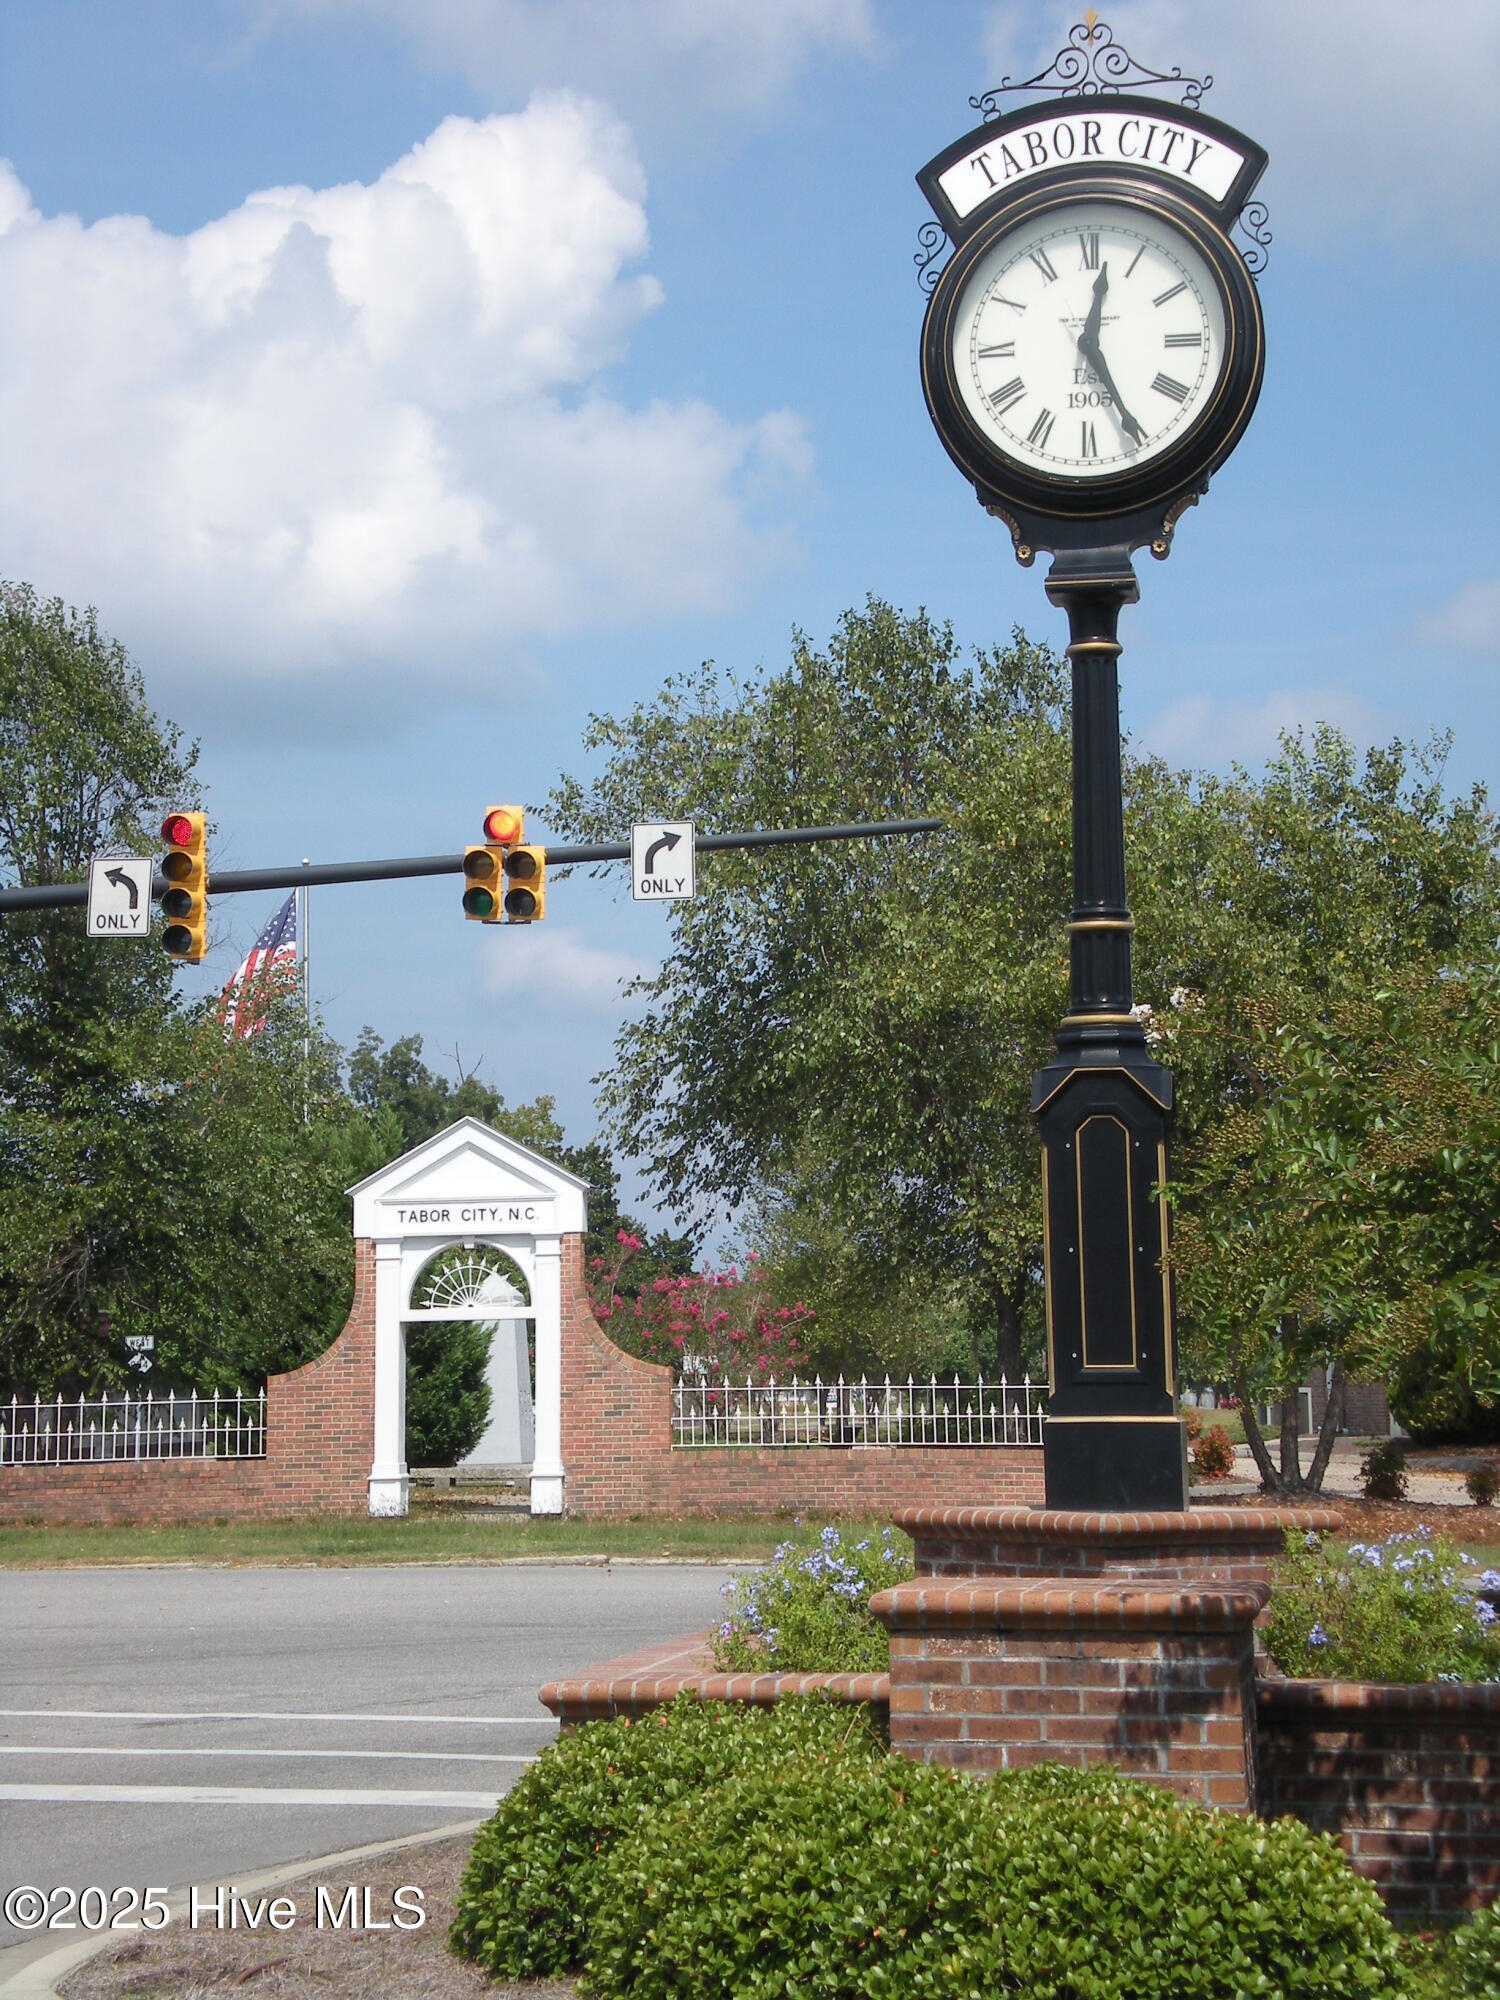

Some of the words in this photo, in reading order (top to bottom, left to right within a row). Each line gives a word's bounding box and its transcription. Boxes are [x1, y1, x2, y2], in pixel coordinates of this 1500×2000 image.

[970, 121, 1104, 189] TABOR
[1117, 120, 1213, 176] CITY
[1078, 232, 1099, 271] XII
[1027, 247, 1058, 287] XI
[1072, 368, 1104, 385] Es
[1067, 390, 1113, 409] 1905
[1081, 420, 1099, 458] VI
[641, 878, 685, 894] ONLY
[96, 914, 140, 929] ONLY
[398, 1209, 450, 1223] TABOR
[461, 1208, 503, 1222] CITY,
